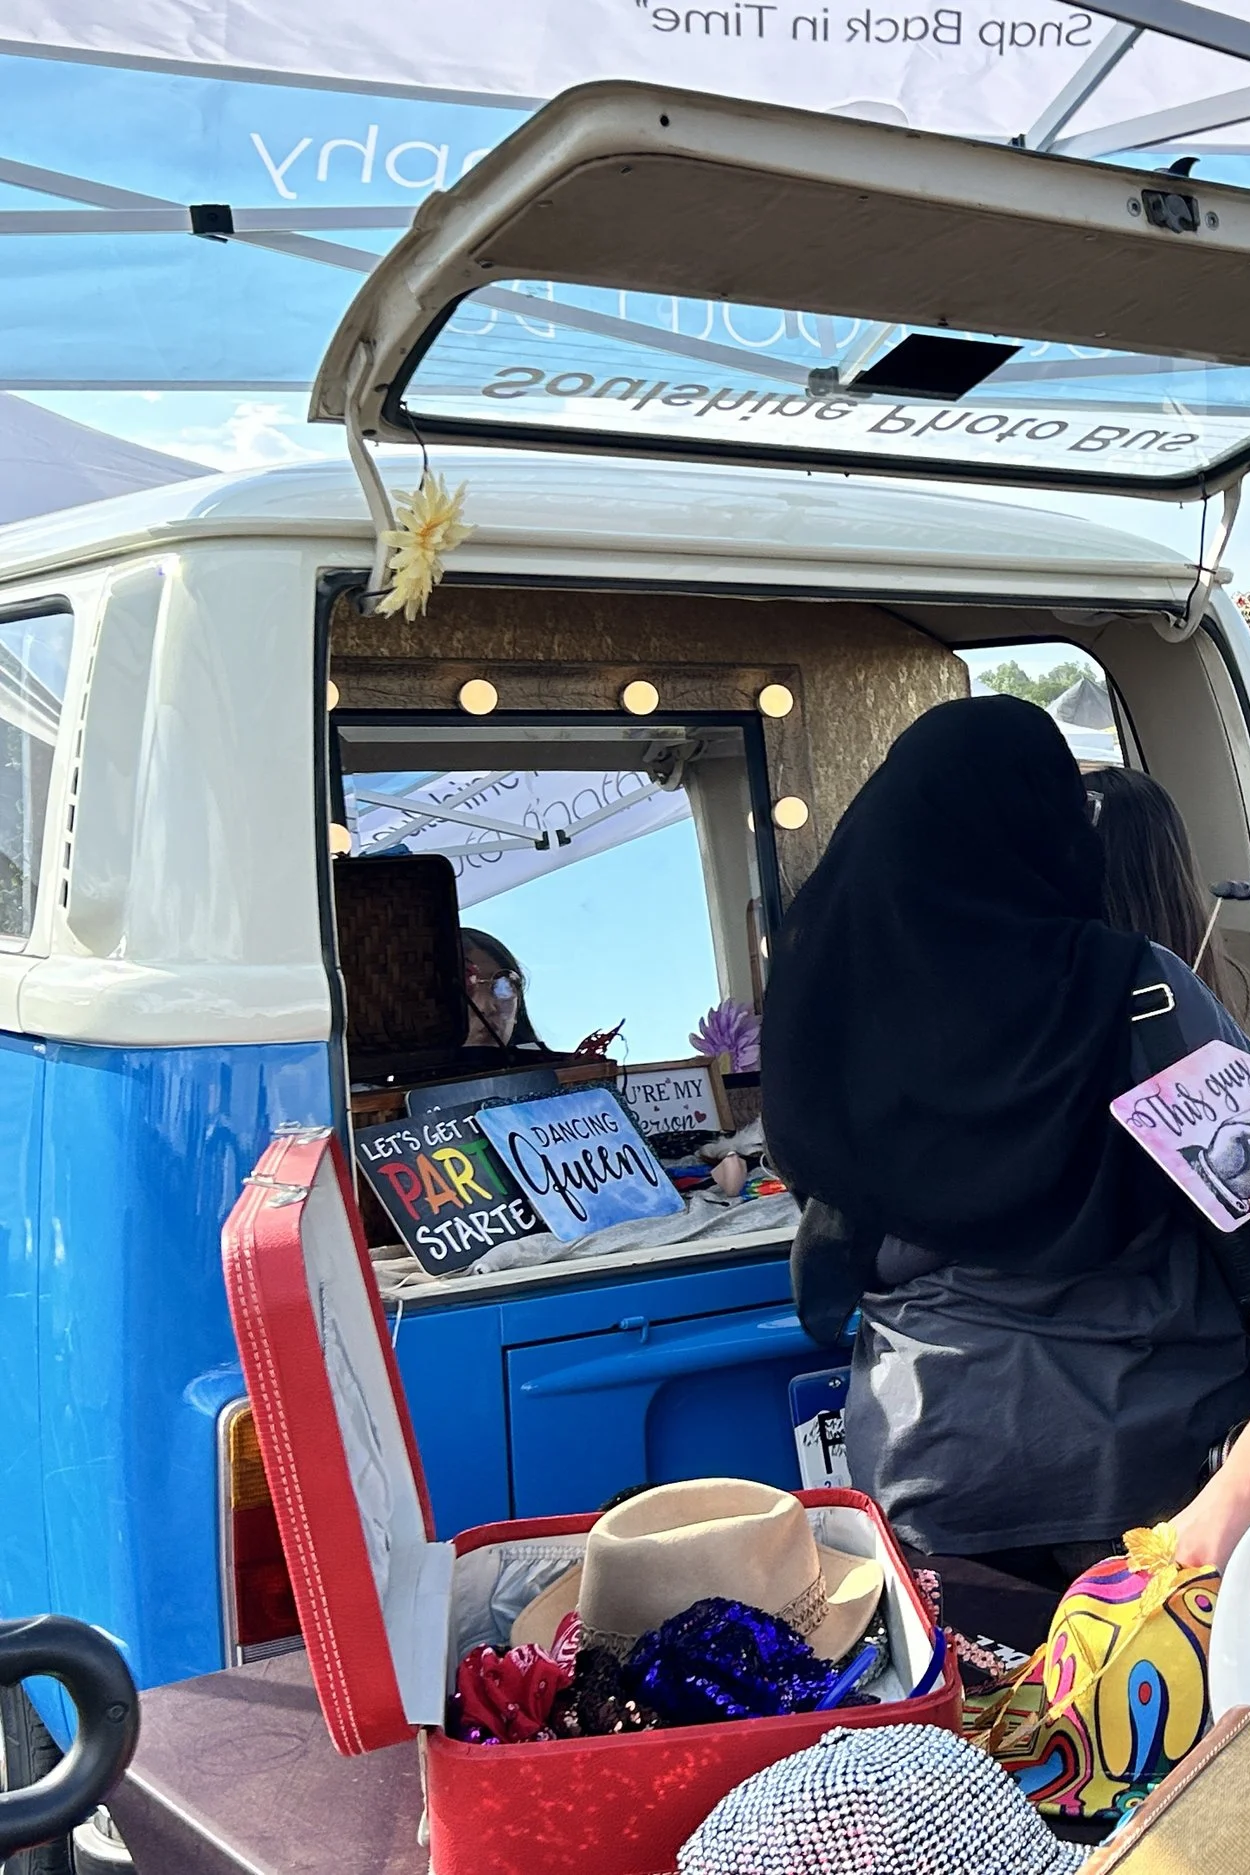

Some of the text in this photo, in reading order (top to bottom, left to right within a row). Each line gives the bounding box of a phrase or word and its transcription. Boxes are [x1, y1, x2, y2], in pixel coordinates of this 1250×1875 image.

[625, 1079, 703, 1104] U'RE MY
[1125, 1082, 1217, 1137] This
[360, 1130, 421, 1161] LET'S
[423, 1119, 463, 1146] GET
[530, 1112, 619, 1148] DANCING
[376, 1138, 508, 1221] PART
[508, 1131, 659, 1222] Queen
[416, 1199, 536, 1260] STARTE
